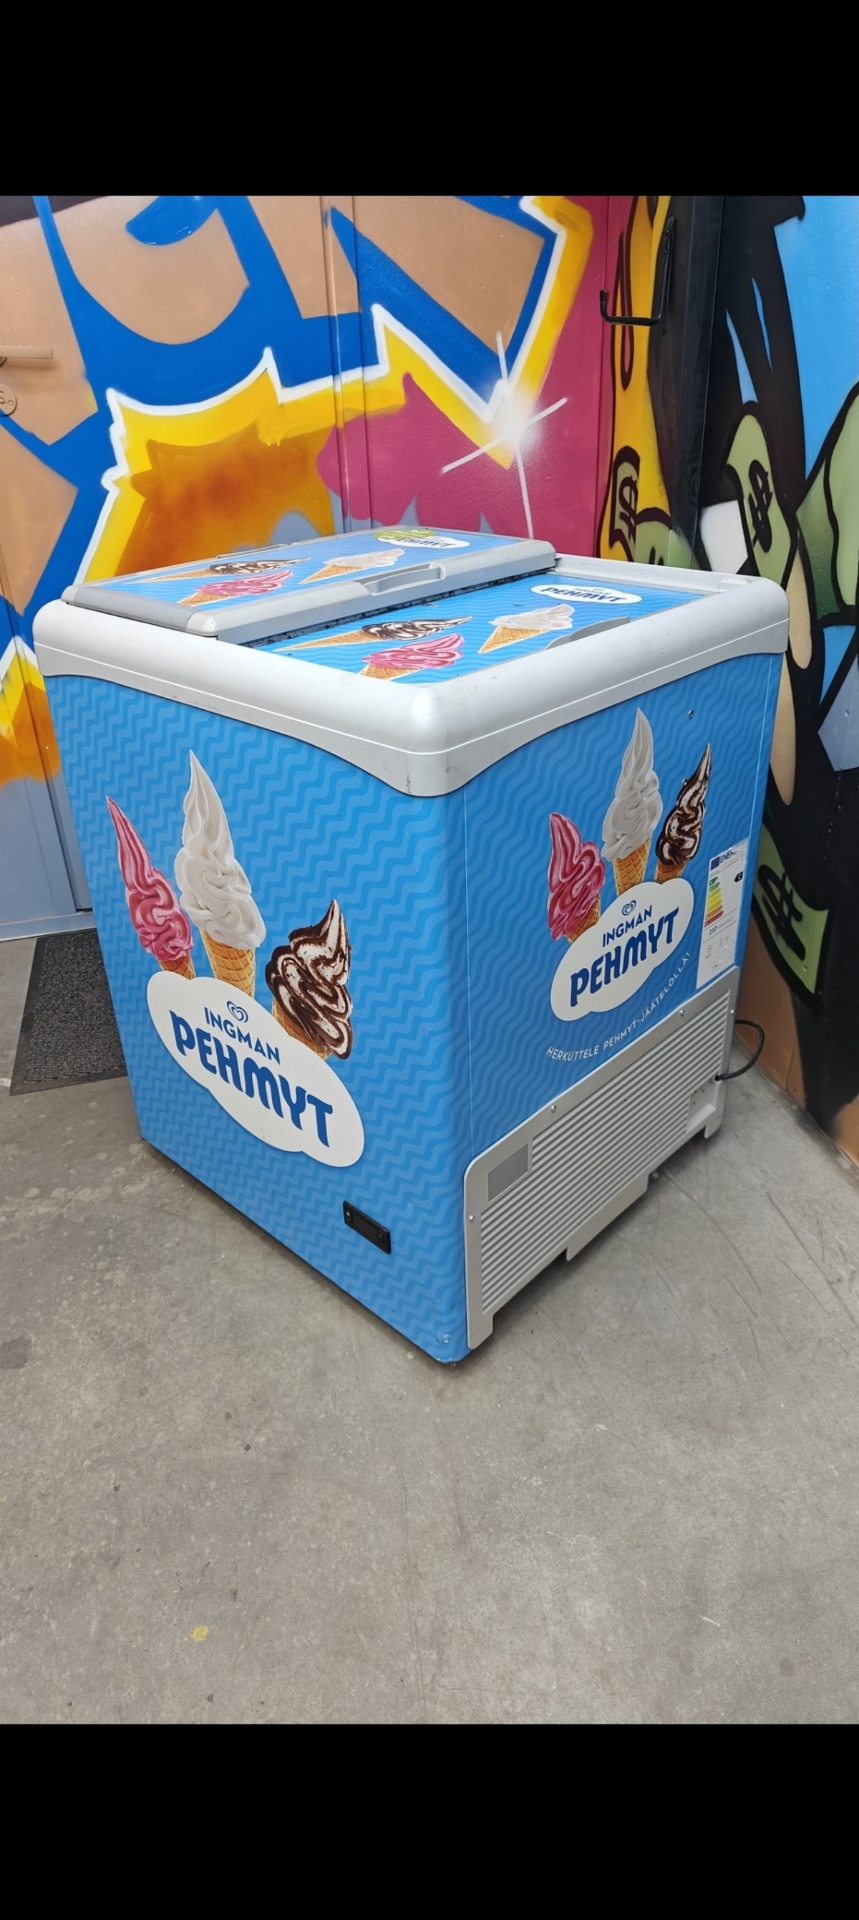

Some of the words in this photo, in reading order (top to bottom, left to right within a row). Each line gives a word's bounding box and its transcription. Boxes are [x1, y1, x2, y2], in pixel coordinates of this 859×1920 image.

[540, 586, 628, 602] PEHMYT
[602, 905, 653, 948] INGMAN
[570, 907, 679, 1007] PEHMYT
[203, 1006, 281, 1066] INGMAN
[546, 1045, 600, 1062] HERKUTTELE
[168, 1009, 334, 1148] PEHMYT
